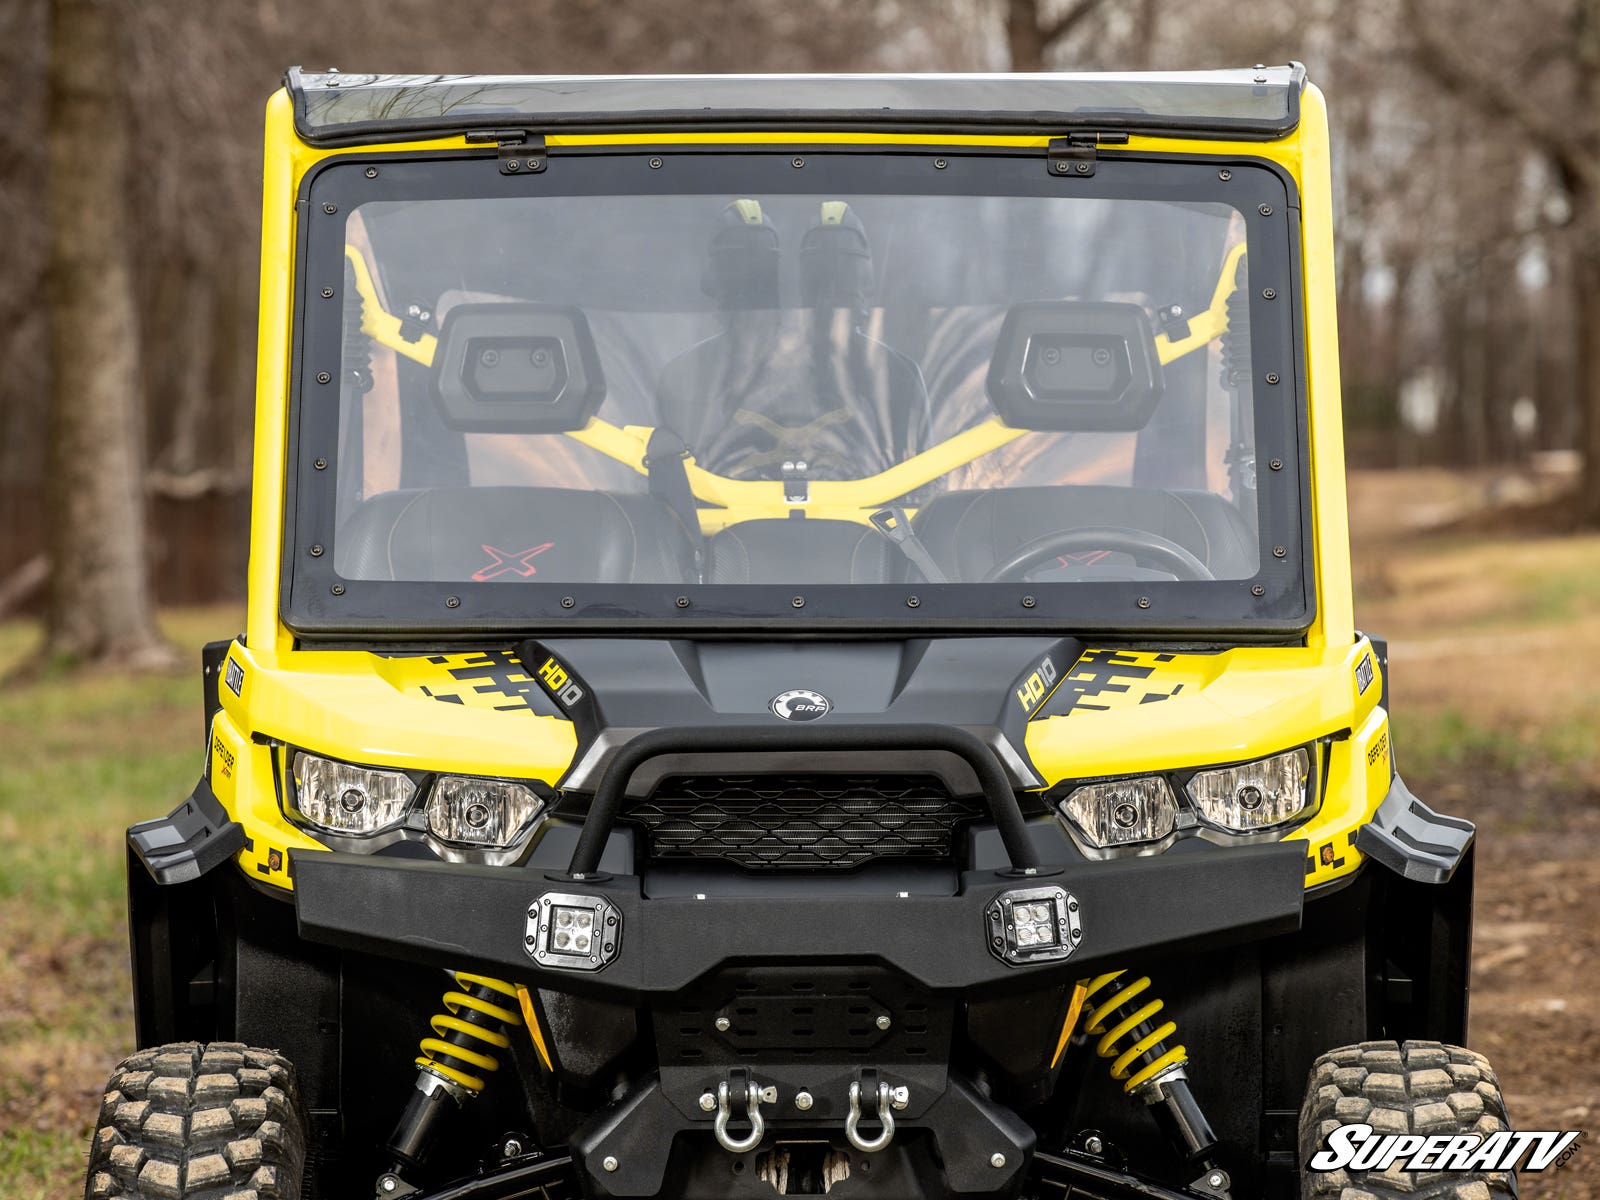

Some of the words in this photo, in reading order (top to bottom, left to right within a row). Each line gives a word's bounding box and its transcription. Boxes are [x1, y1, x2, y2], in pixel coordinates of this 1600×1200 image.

[538, 657, 583, 707] HD10
[1016, 656, 1057, 712] HD10
[794, 704, 826, 712] BRP
